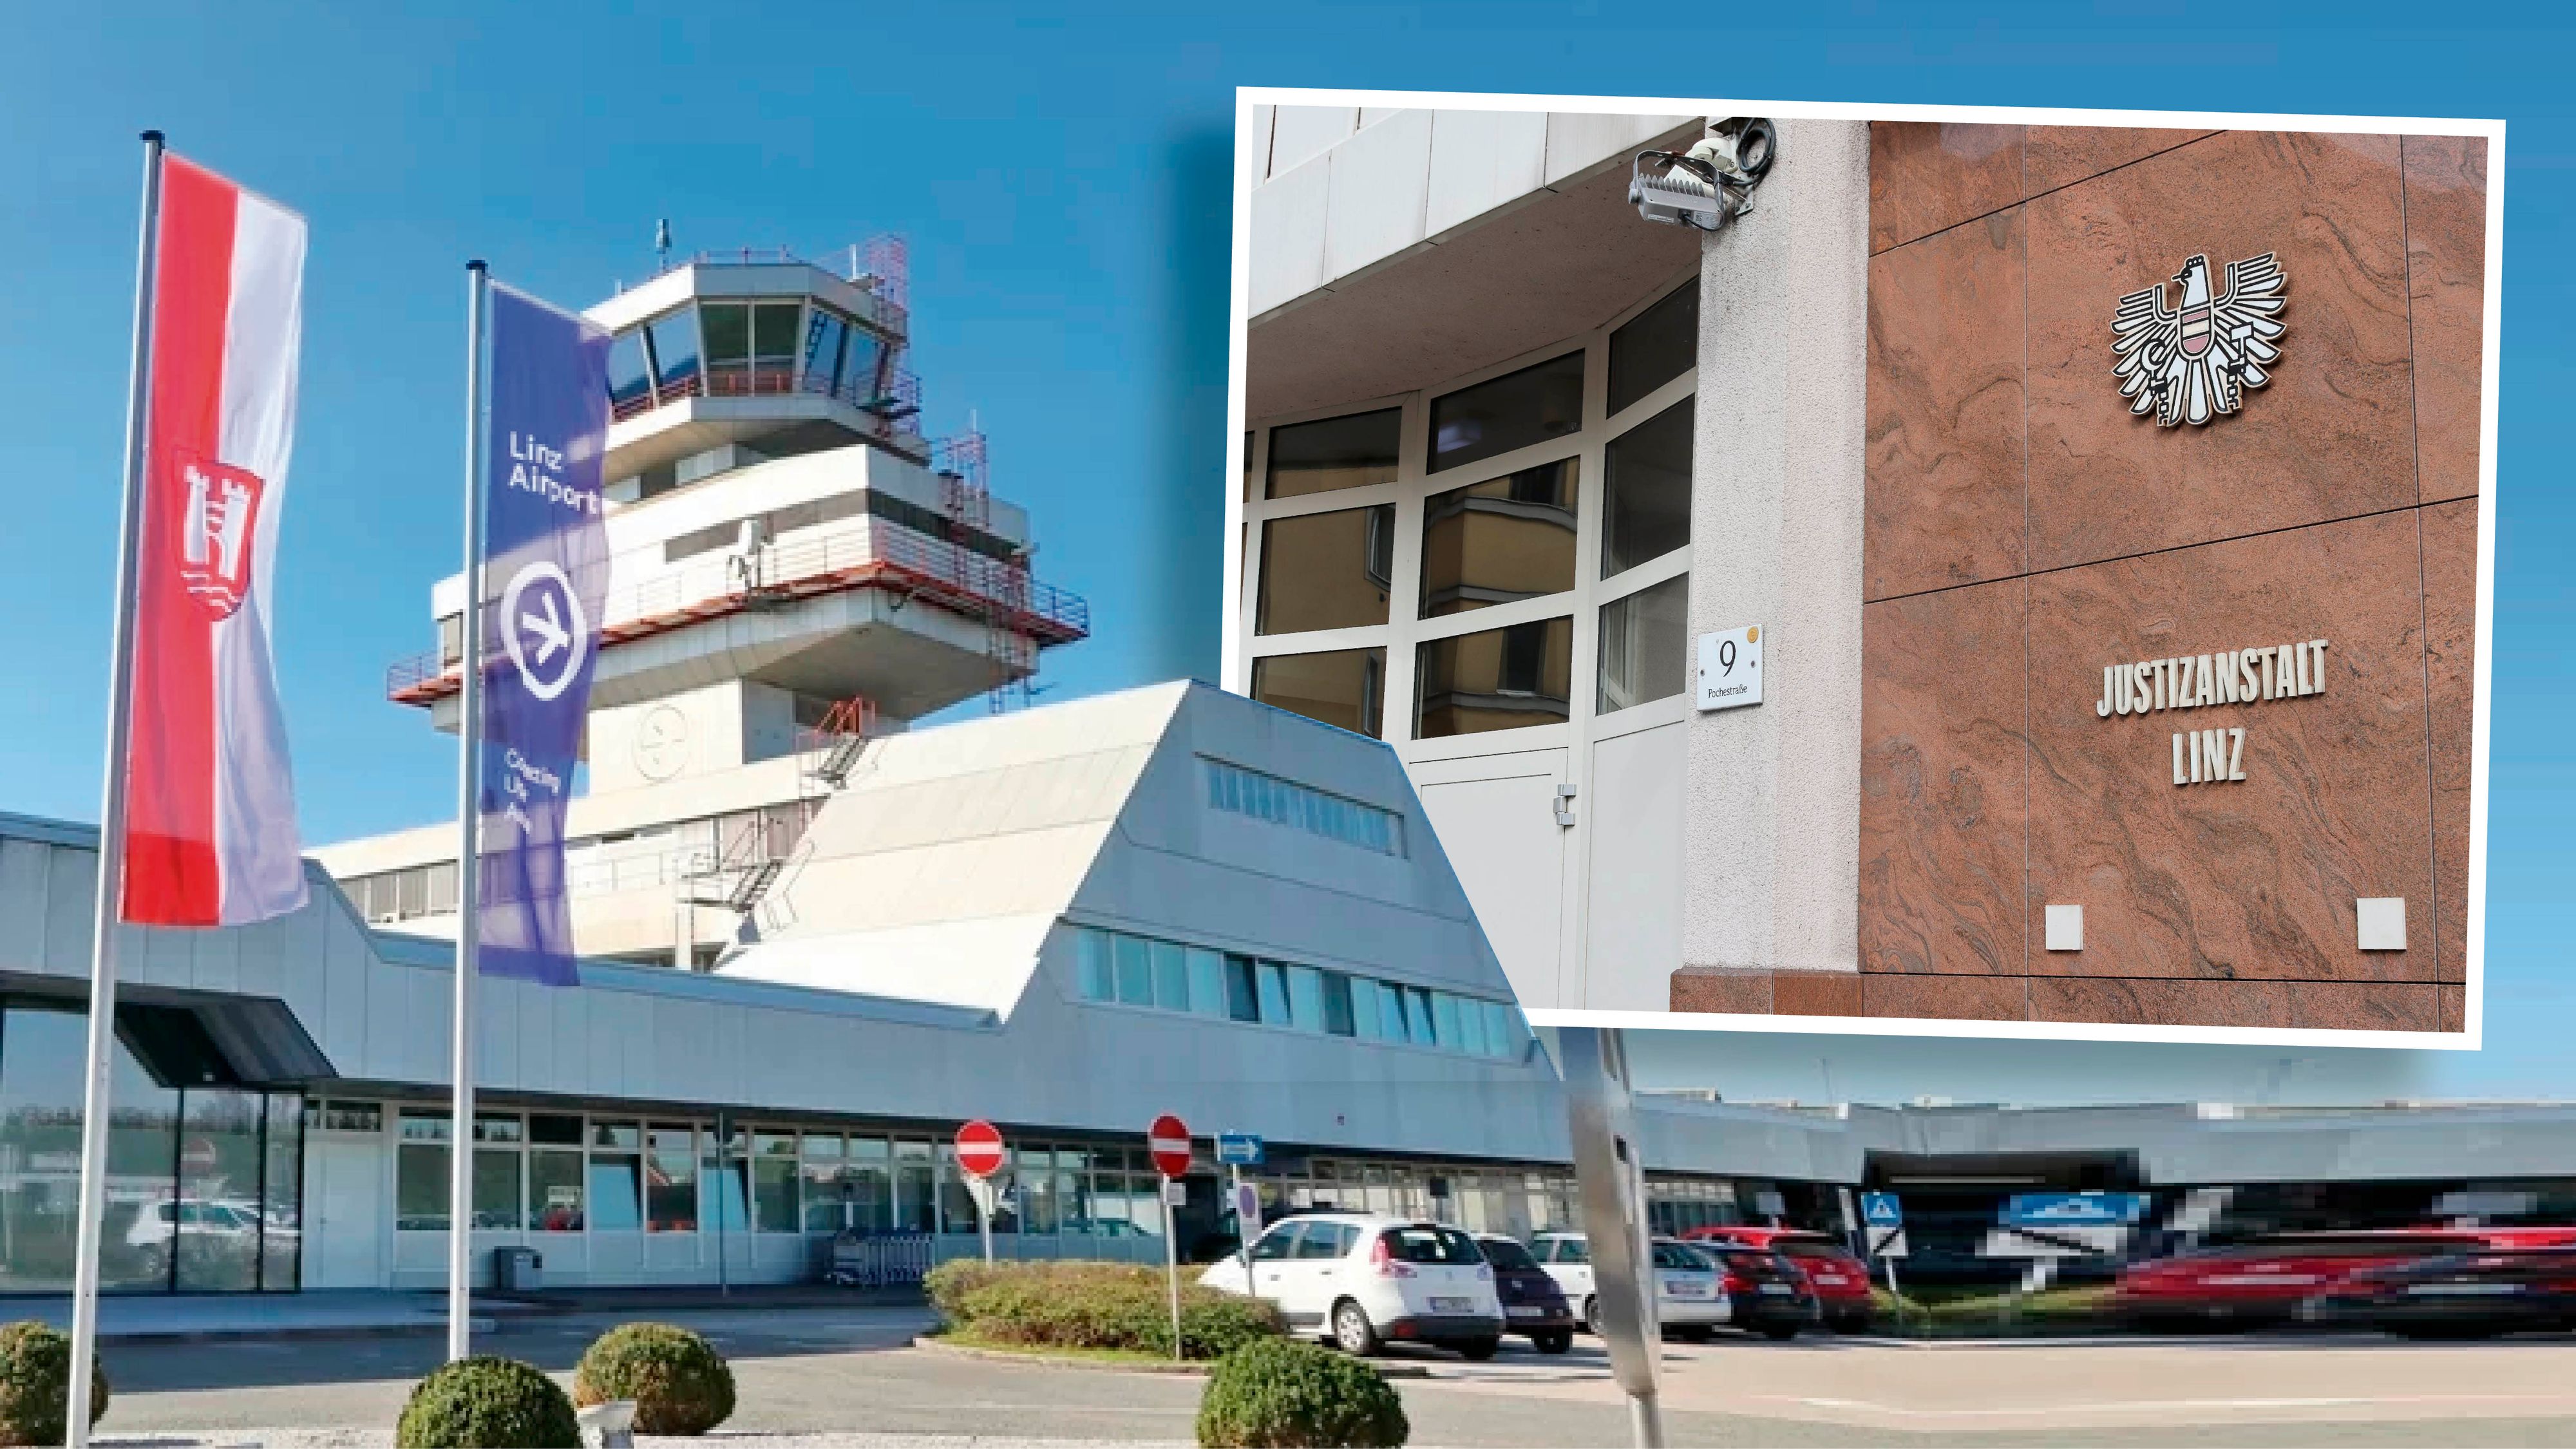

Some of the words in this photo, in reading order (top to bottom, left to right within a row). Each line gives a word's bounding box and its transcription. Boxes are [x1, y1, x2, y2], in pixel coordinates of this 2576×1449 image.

[510, 431, 562, 472] Linz
[508, 463, 599, 515] Airport
[1719, 640, 1736, 677] 9
[2096, 639, 2329, 717] JUSTIZANSTALT
[1708, 684, 1748, 699] Pochestraße
[2172, 727, 2247, 784] LINZ
